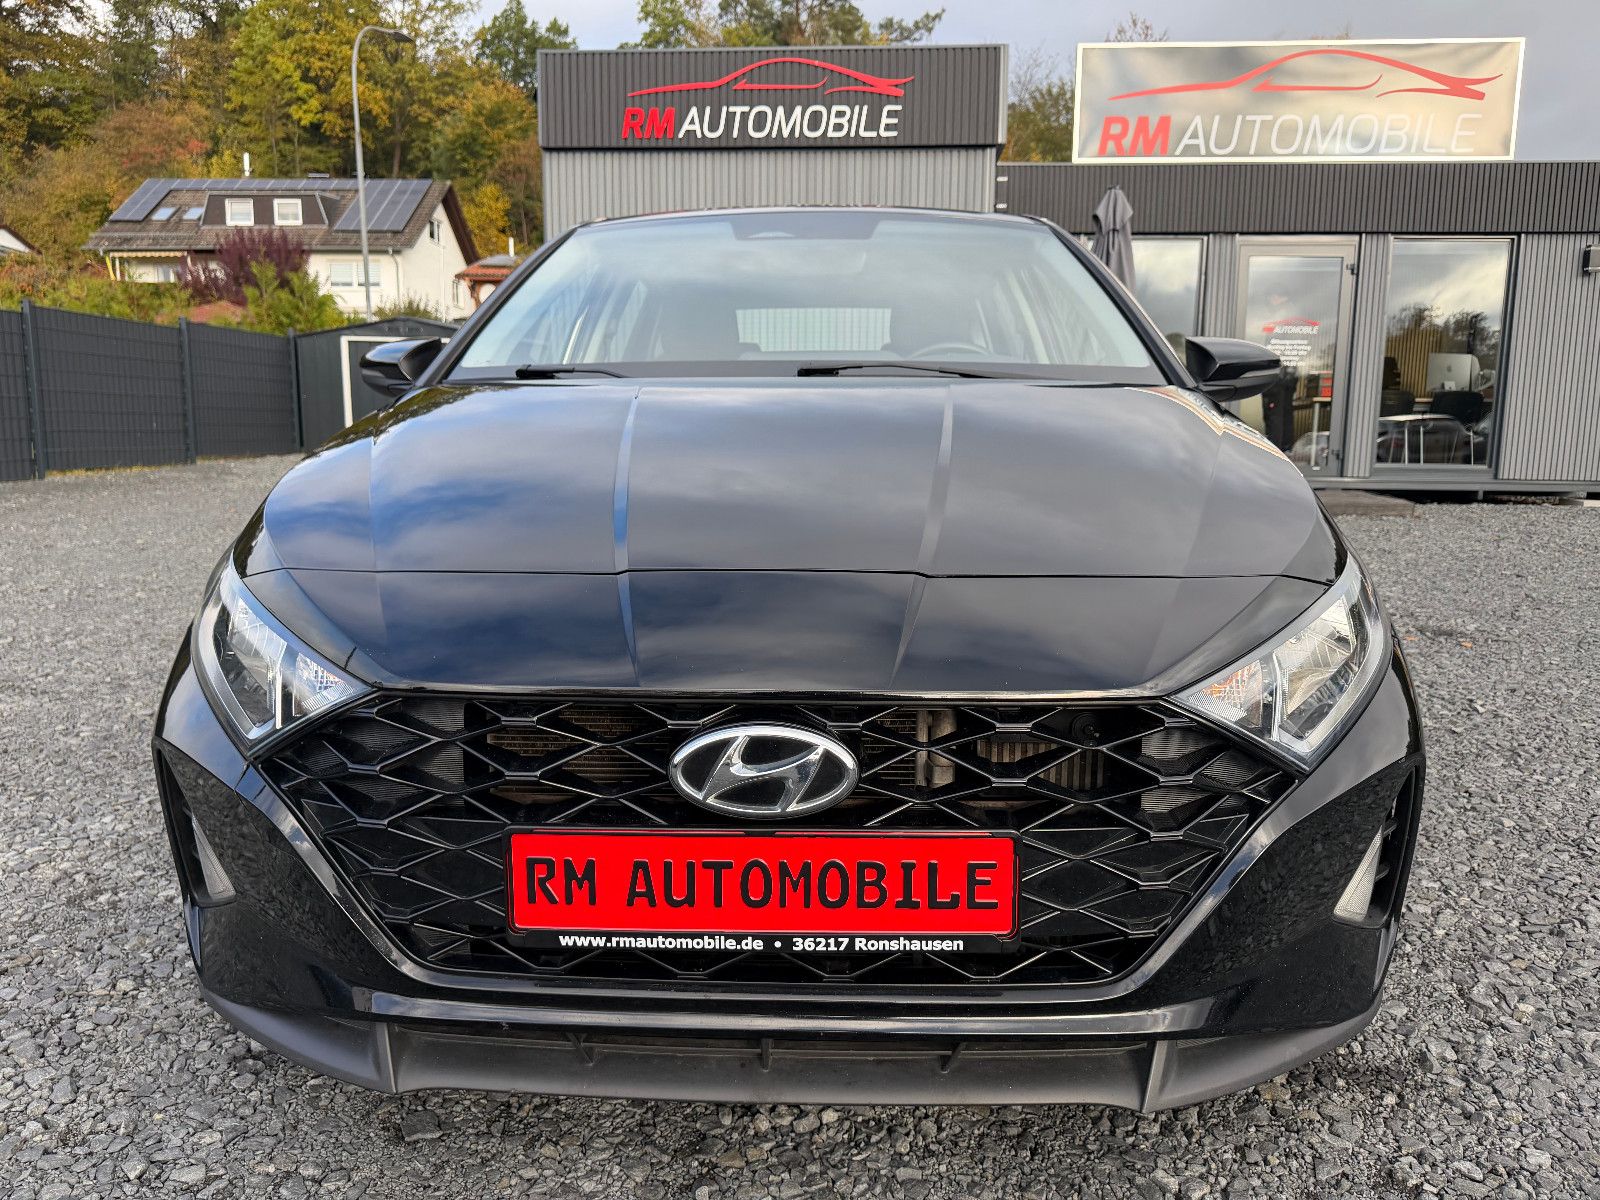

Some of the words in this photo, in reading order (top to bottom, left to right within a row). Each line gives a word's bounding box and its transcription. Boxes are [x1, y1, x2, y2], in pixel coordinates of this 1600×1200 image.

[621, 106, 676, 139] RM
[678, 104, 903, 138] AUTOMOBILE
[1097, 115, 1172, 156] RM
[1174, 113, 1483, 155] AUTOMOBILE
[525, 856, 598, 906] RM
[626, 858, 999, 910] AUTOMOBILE
[558, 934, 764, 951] www.rmautomobile.de
[792, 937, 850, 951] 36217
[854, 936, 964, 951] Ronshausen
